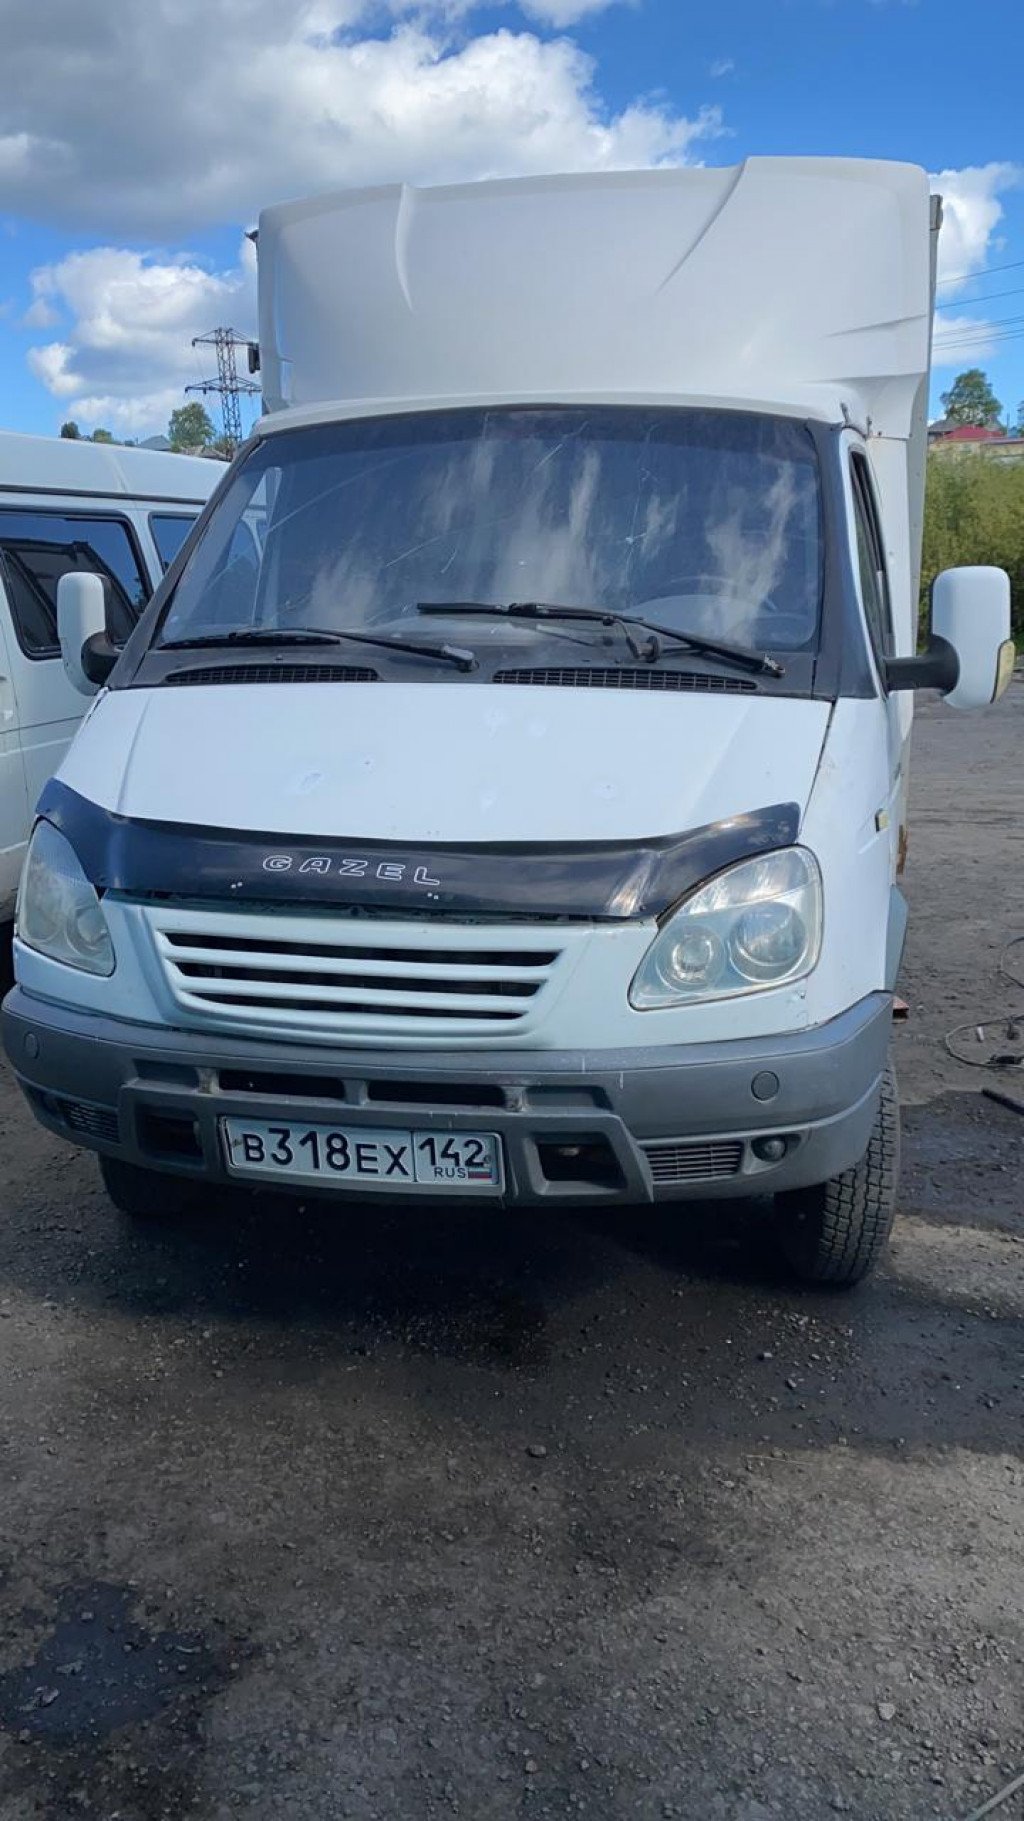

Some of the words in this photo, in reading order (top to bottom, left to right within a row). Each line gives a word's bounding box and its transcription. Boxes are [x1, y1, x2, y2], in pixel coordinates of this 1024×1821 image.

[262, 854, 441, 886] GAZEL
[418, 1137, 485, 1168] 142
[434, 1167, 466, 1179] RUS
